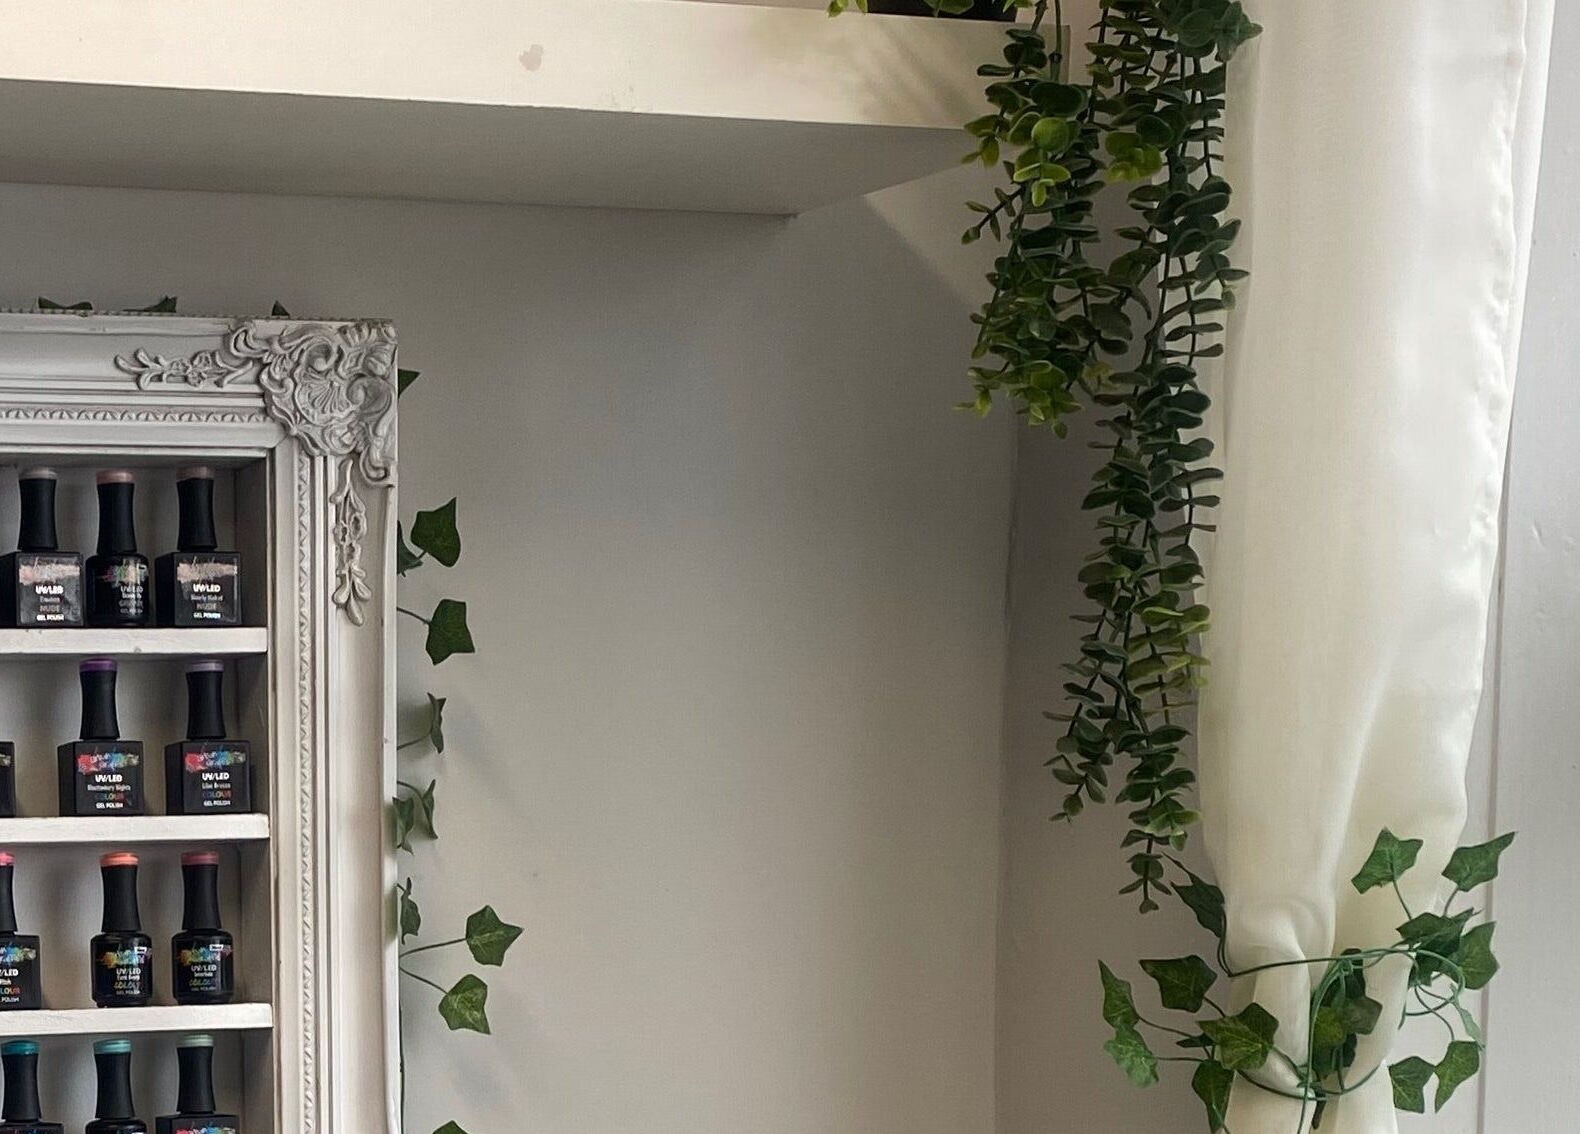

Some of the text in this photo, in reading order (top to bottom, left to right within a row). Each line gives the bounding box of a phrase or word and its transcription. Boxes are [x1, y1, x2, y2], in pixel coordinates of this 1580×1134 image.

[192, 584, 221, 594] UV/LED
[94, 775, 123, 784] UV/LED
[201, 773, 230, 782] UV/LED
